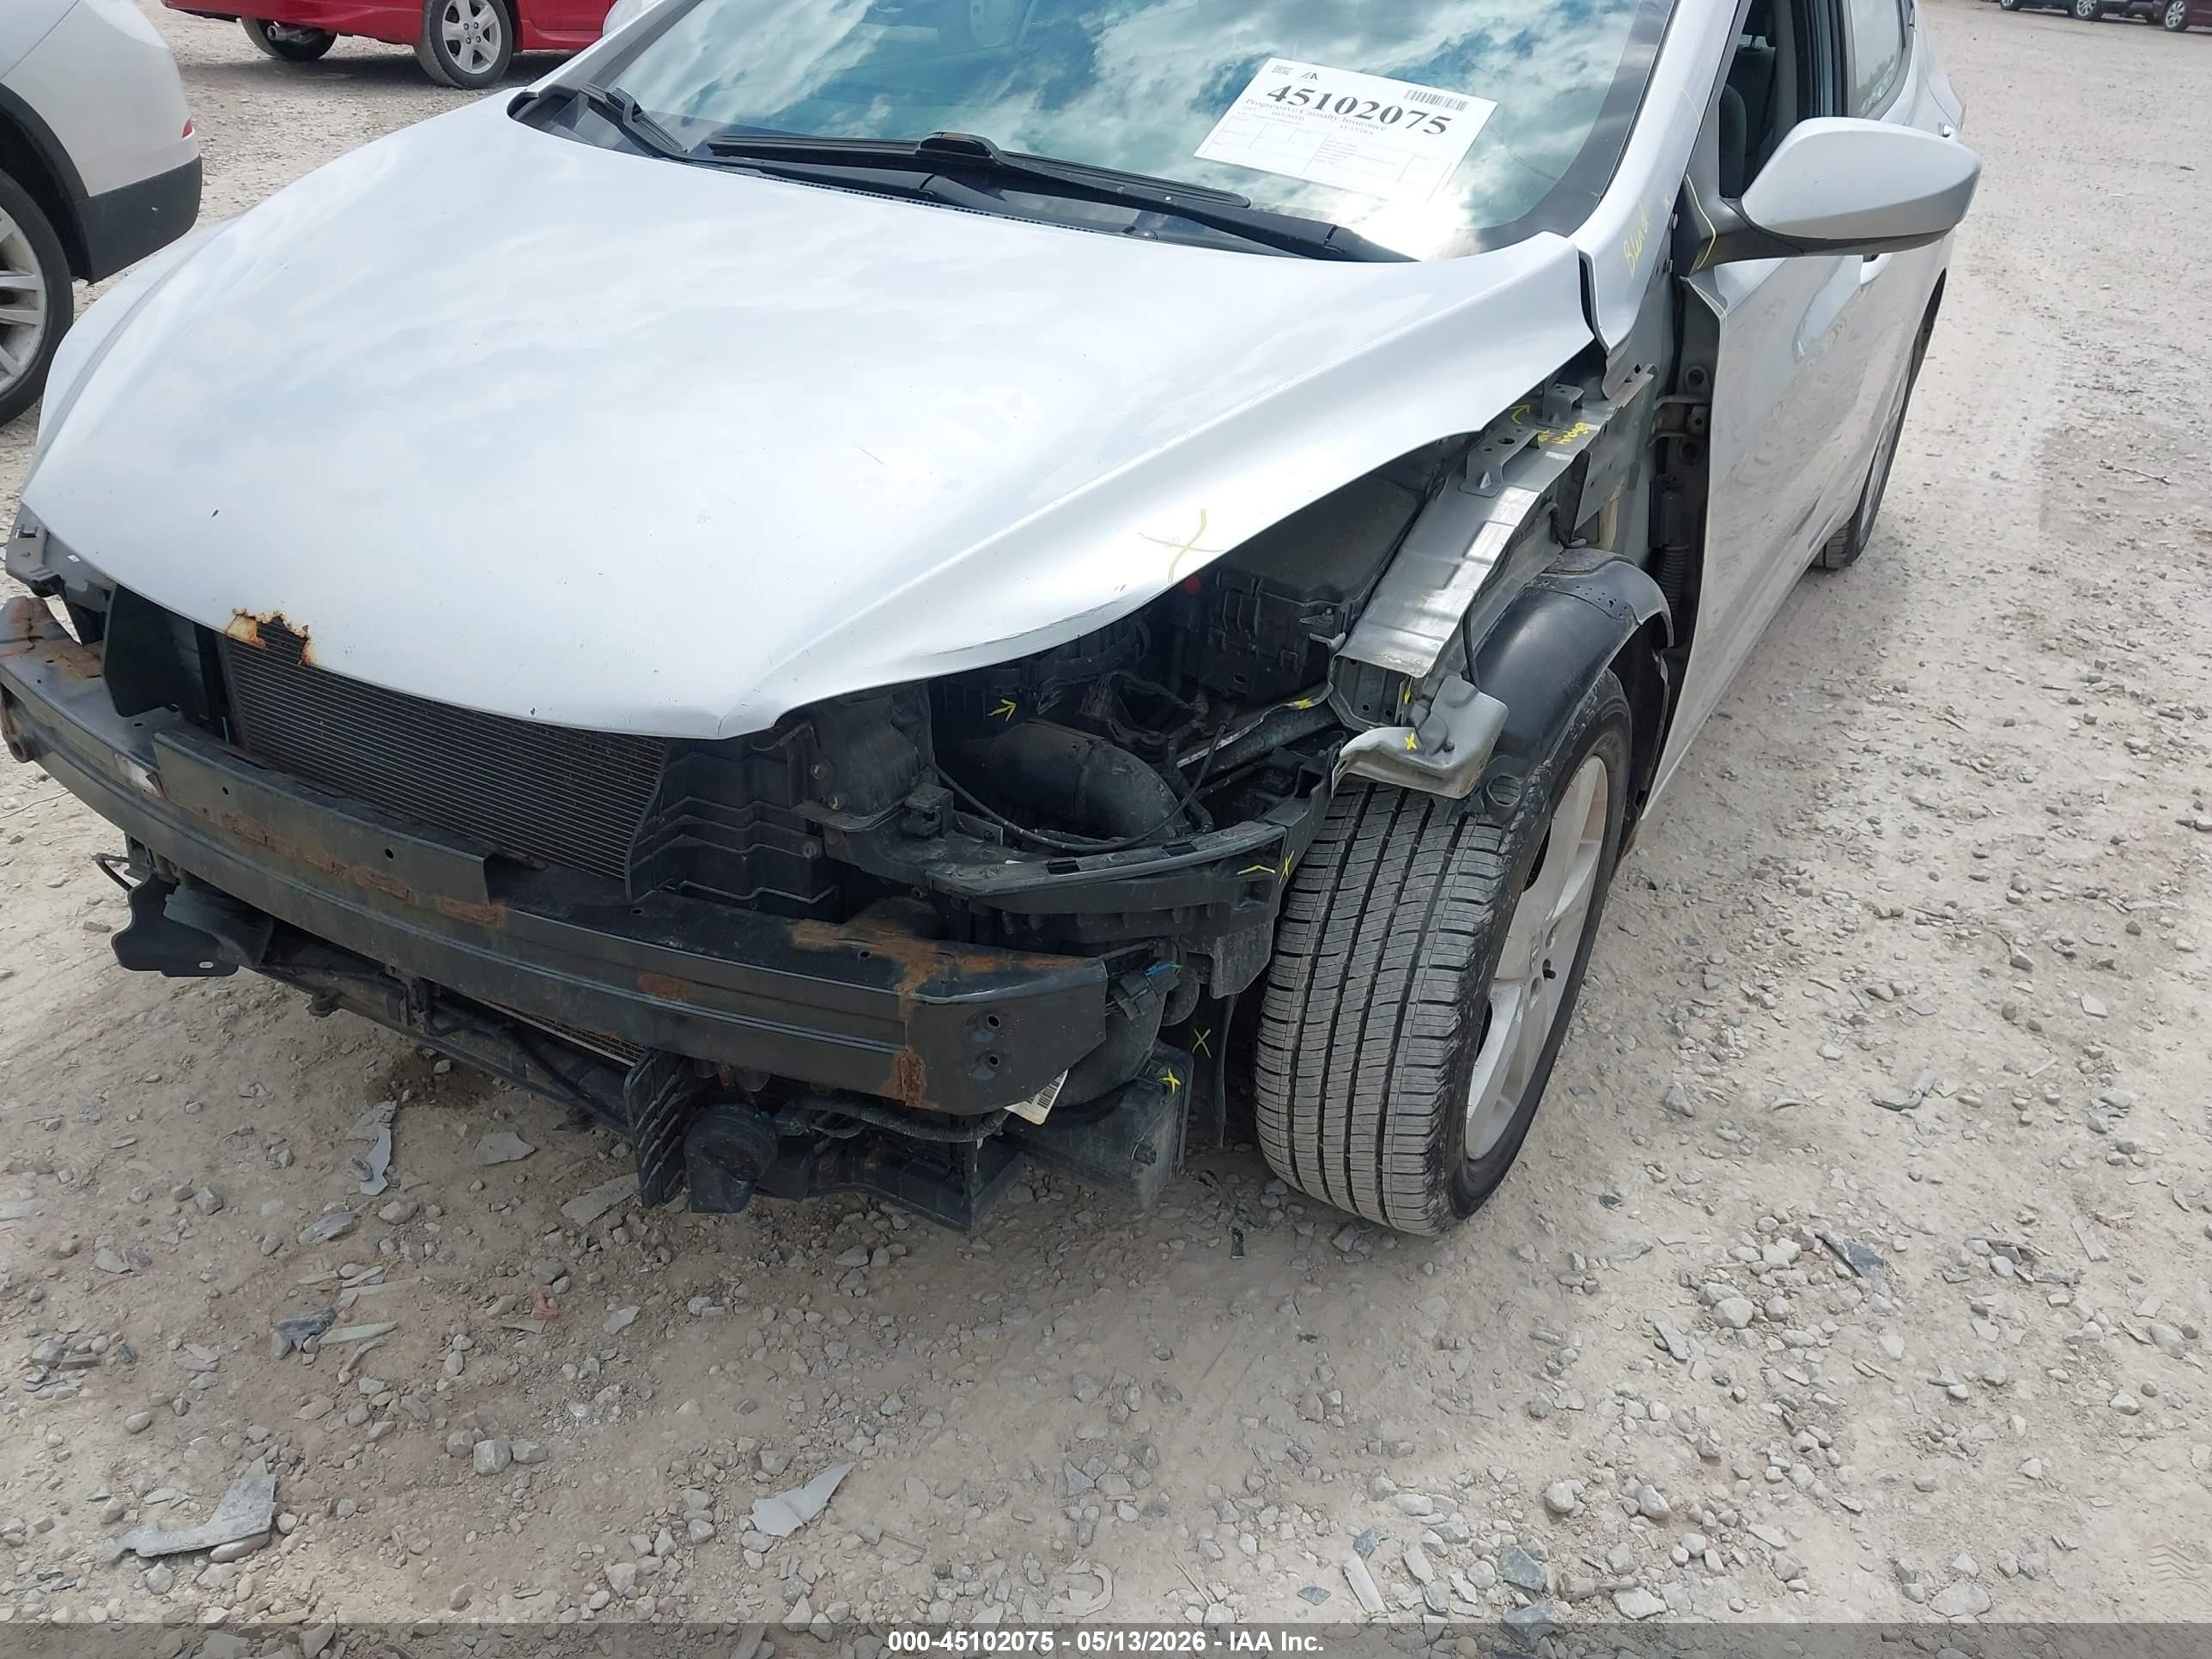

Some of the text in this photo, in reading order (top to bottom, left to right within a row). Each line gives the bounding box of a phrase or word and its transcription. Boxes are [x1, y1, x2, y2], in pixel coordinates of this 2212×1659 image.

[1246, 98, 1298, 112] Progressive
[1300, 108, 1337, 122] Casualty
[1342, 117, 1387, 131] Insurance
[1267, 85, 1453, 135] 45102075
